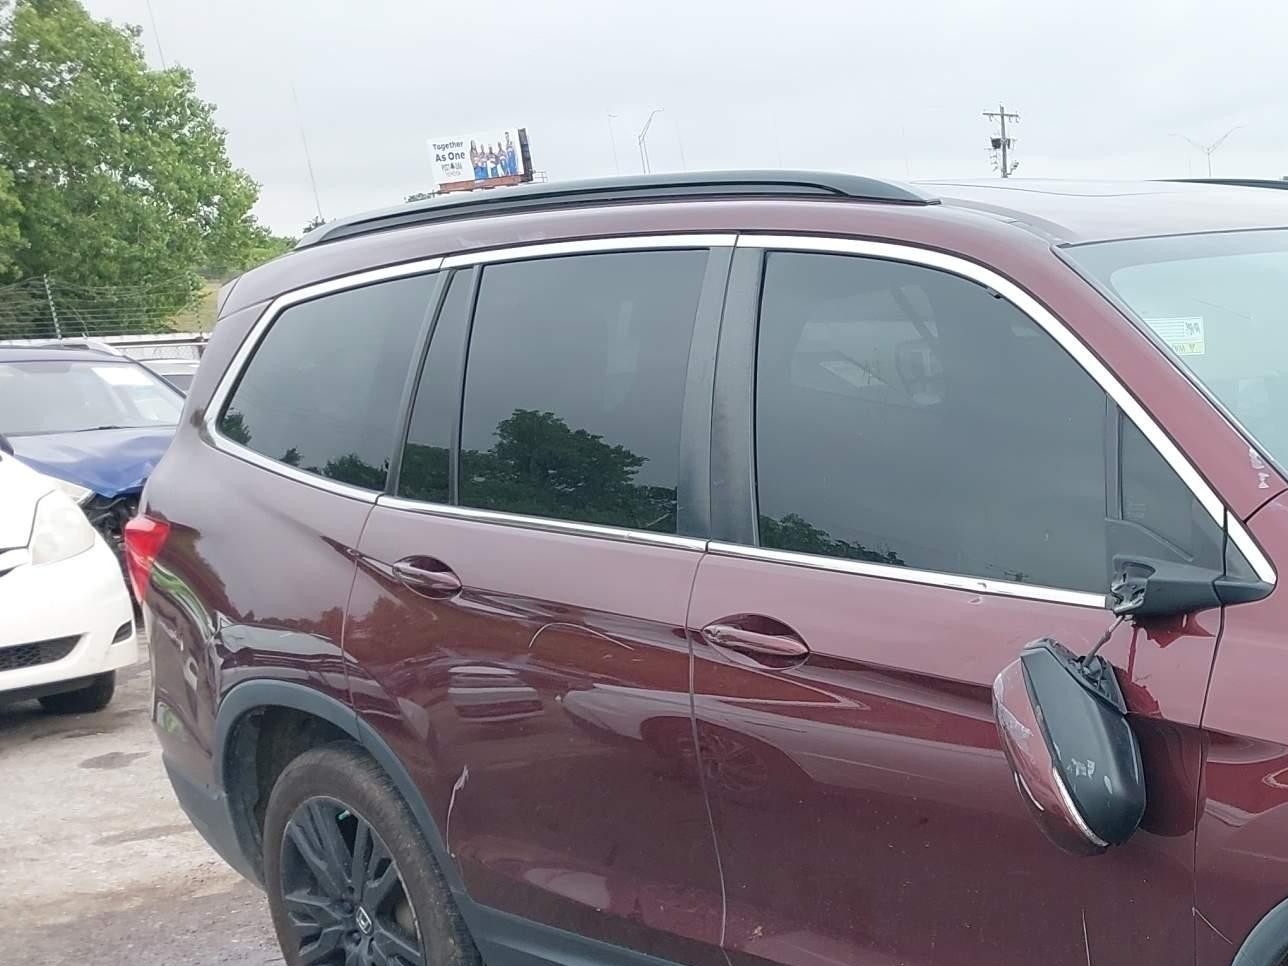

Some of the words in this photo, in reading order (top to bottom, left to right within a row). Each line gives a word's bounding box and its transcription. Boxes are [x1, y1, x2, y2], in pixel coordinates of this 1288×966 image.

[432, 141, 463, 151] Together
[435, 154, 447, 162] As
[447, 152, 465, 161] One
